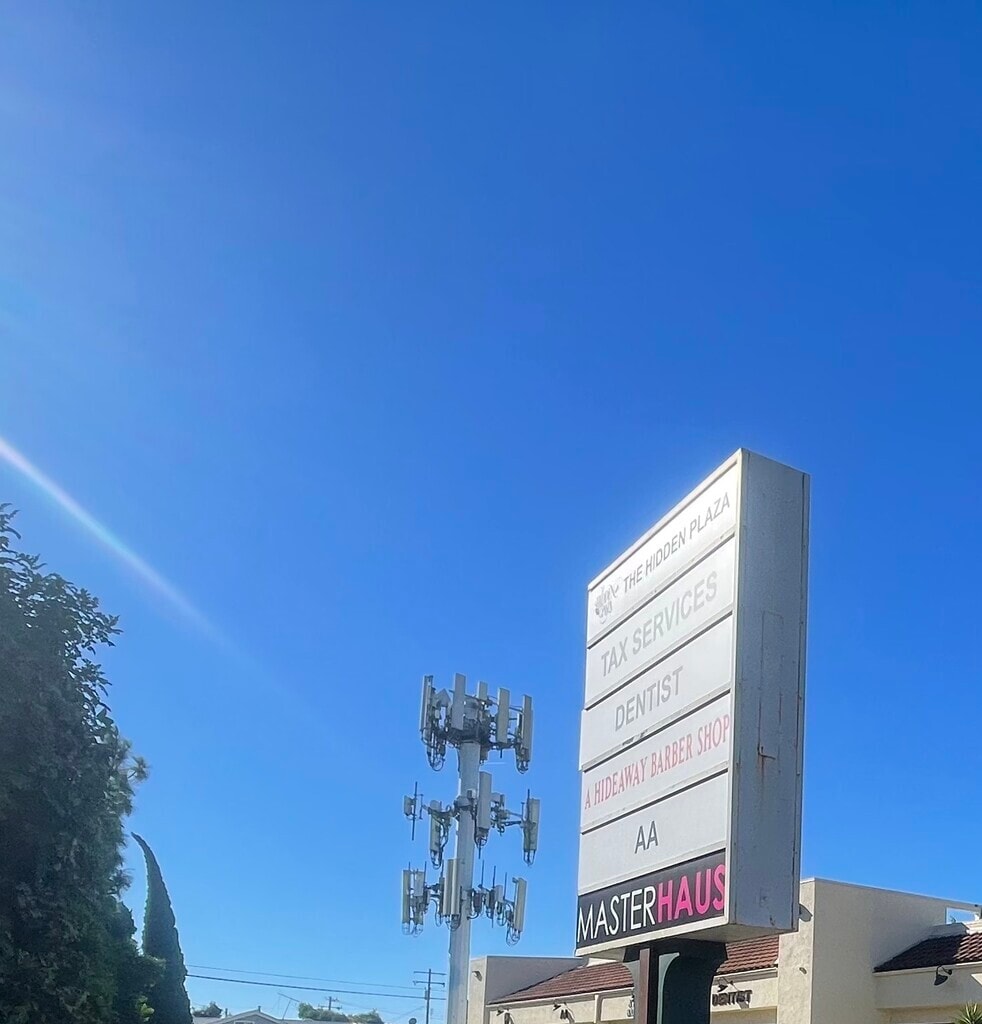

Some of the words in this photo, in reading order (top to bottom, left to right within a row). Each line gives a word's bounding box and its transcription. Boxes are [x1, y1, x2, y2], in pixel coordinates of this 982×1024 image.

[624, 564, 643, 594] THE
[645, 527, 686, 577] HIDDEN
[689, 492, 730, 540] PLAZA
[601, 636, 628, 677] TAX
[632, 571, 718, 656] SERVICES
[615, 666, 684, 732] DENTIST
[584, 788, 592, 810] A
[594, 756, 648, 805] HIDEAWAY
[650, 733, 693, 778] BARBER
[697, 714, 730, 757] SHOP
[634, 820, 659, 854] AA
[712, 989, 753, 1007] DENTIST
